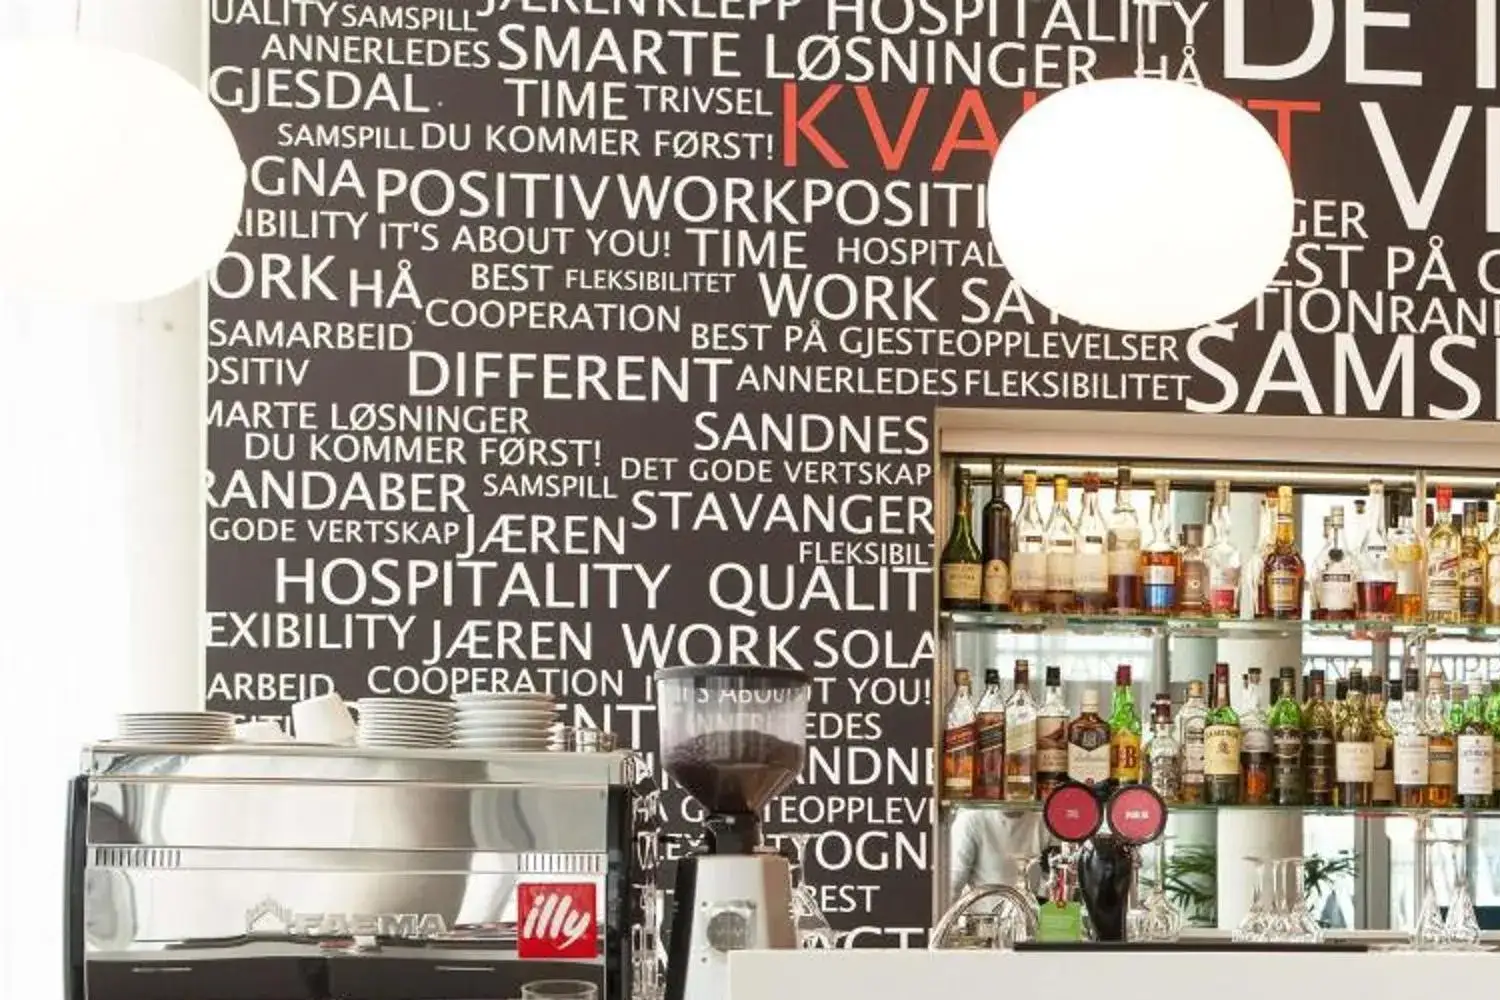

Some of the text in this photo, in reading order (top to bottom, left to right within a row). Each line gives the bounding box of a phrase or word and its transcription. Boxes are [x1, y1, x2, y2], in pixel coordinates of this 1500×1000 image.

[341, 3, 478, 32] SAMSPILL
[826, 0, 1208, 45] HOSPITALITY
[261, 33, 491, 69] ANNERLEDES
[497, 23, 1097, 87] SMARTE LØSNINGER
[1222, 0, 1497, 89] DET
[208, 66, 429, 113] GJESDAL
[503, 77, 773, 121] TIME TRIVSEL
[277, 122, 415, 151] SAMSPILL
[421, 122, 773, 161] DU KOMMER FØRST!
[248, 155, 366, 198] GNA
[377, 168, 610, 221] POSITIV
[616, 173, 799, 225] WORK
[235, 208, 368, 240] IBILITY
[380, 221, 670, 258] IT'S ABOUT YOU!
[685, 227, 808, 270] TIME
[1387, 235, 1457, 293] PÅ
[349, 258, 423, 310] HÅ
[471, 263, 554, 292] BEST
[565, 269, 737, 293] FLEKSIBILITET
[758, 272, 938, 322] WORK
[209, 318, 413, 351] SAMARBEID
[425, 298, 680, 333] COOPERATION
[691, 319, 1179, 362] BEST PÅ GJESTEOPPLEVELSER
[409, 350, 734, 403] DIFFERENT
[735, 364, 958, 397] ANNERLEDES
[965, 369, 1192, 401] FLEKSIBILITET
[331, 402, 531, 435] LØSNINGER
[694, 411, 929, 455] SANDNES
[245, 432, 601, 467] DU KOMMER FØRST!
[483, 473, 618, 499] SAMSPILL
[621, 457, 932, 486] DET GODE VERTSKAP
[209, 516, 460, 545] GODE VERTSKAP
[631, 489, 935, 535] STAVANGER
[455, 513, 625, 559] JÆREN
[276, 557, 671, 609] HOSPITALITY
[709, 561, 933, 617] QUALIT
[422, 619, 592, 666] JÆREN
[621, 622, 803, 671] WORK
[813, 628, 934, 670] SOLA
[207, 672, 335, 700] ARBEID
[367, 666, 622, 697] COOPERATION
[847, 677, 931, 705] YOU!
[797, 747, 934, 786] NDN
[815, 830, 934, 871] OGN
[524, 894, 591, 950] illy
